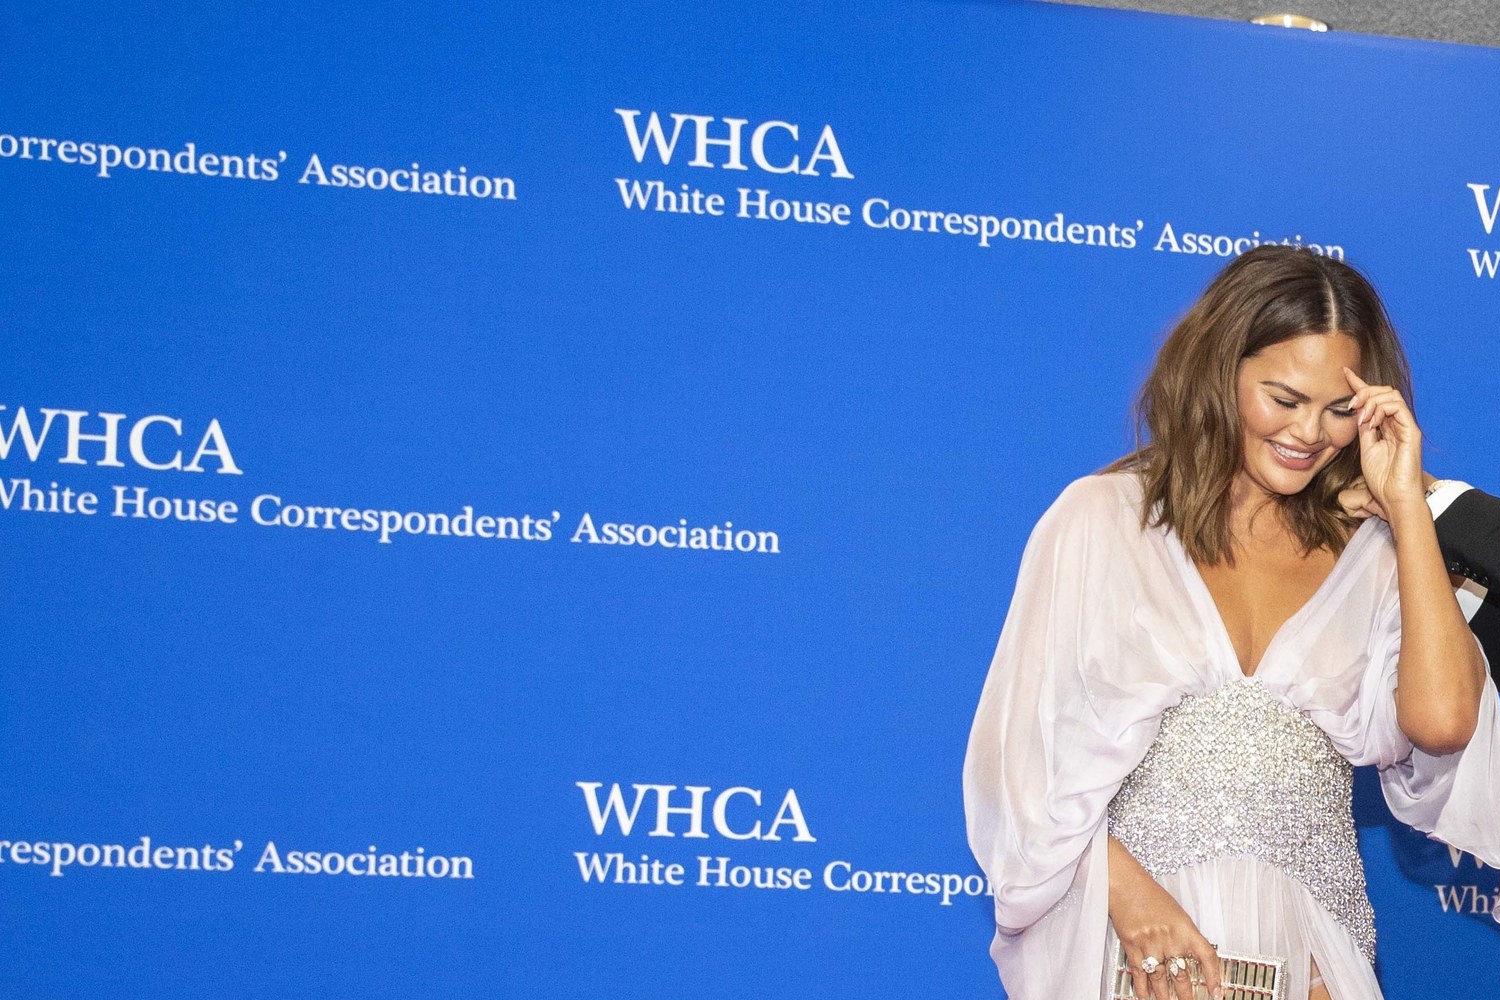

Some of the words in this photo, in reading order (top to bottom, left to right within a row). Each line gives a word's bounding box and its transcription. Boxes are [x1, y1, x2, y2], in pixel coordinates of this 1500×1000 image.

[614, 108, 855, 180] WHCA
[298, 153, 517, 201] Association
[614, 178, 725, 216] White
[736, 187, 851, 226] House
[861, 197, 1144, 249] Correspondents’
[0, 404, 244, 475] WHCA
[111, 485, 239, 524] House
[250, 494, 561, 544] Correspondents’
[570, 512, 781, 554] Association
[575, 781, 817, 843] WHCA
[254, 841, 474, 879] Association
[574, 852, 685, 886] White
[696, 856, 813, 890] House
